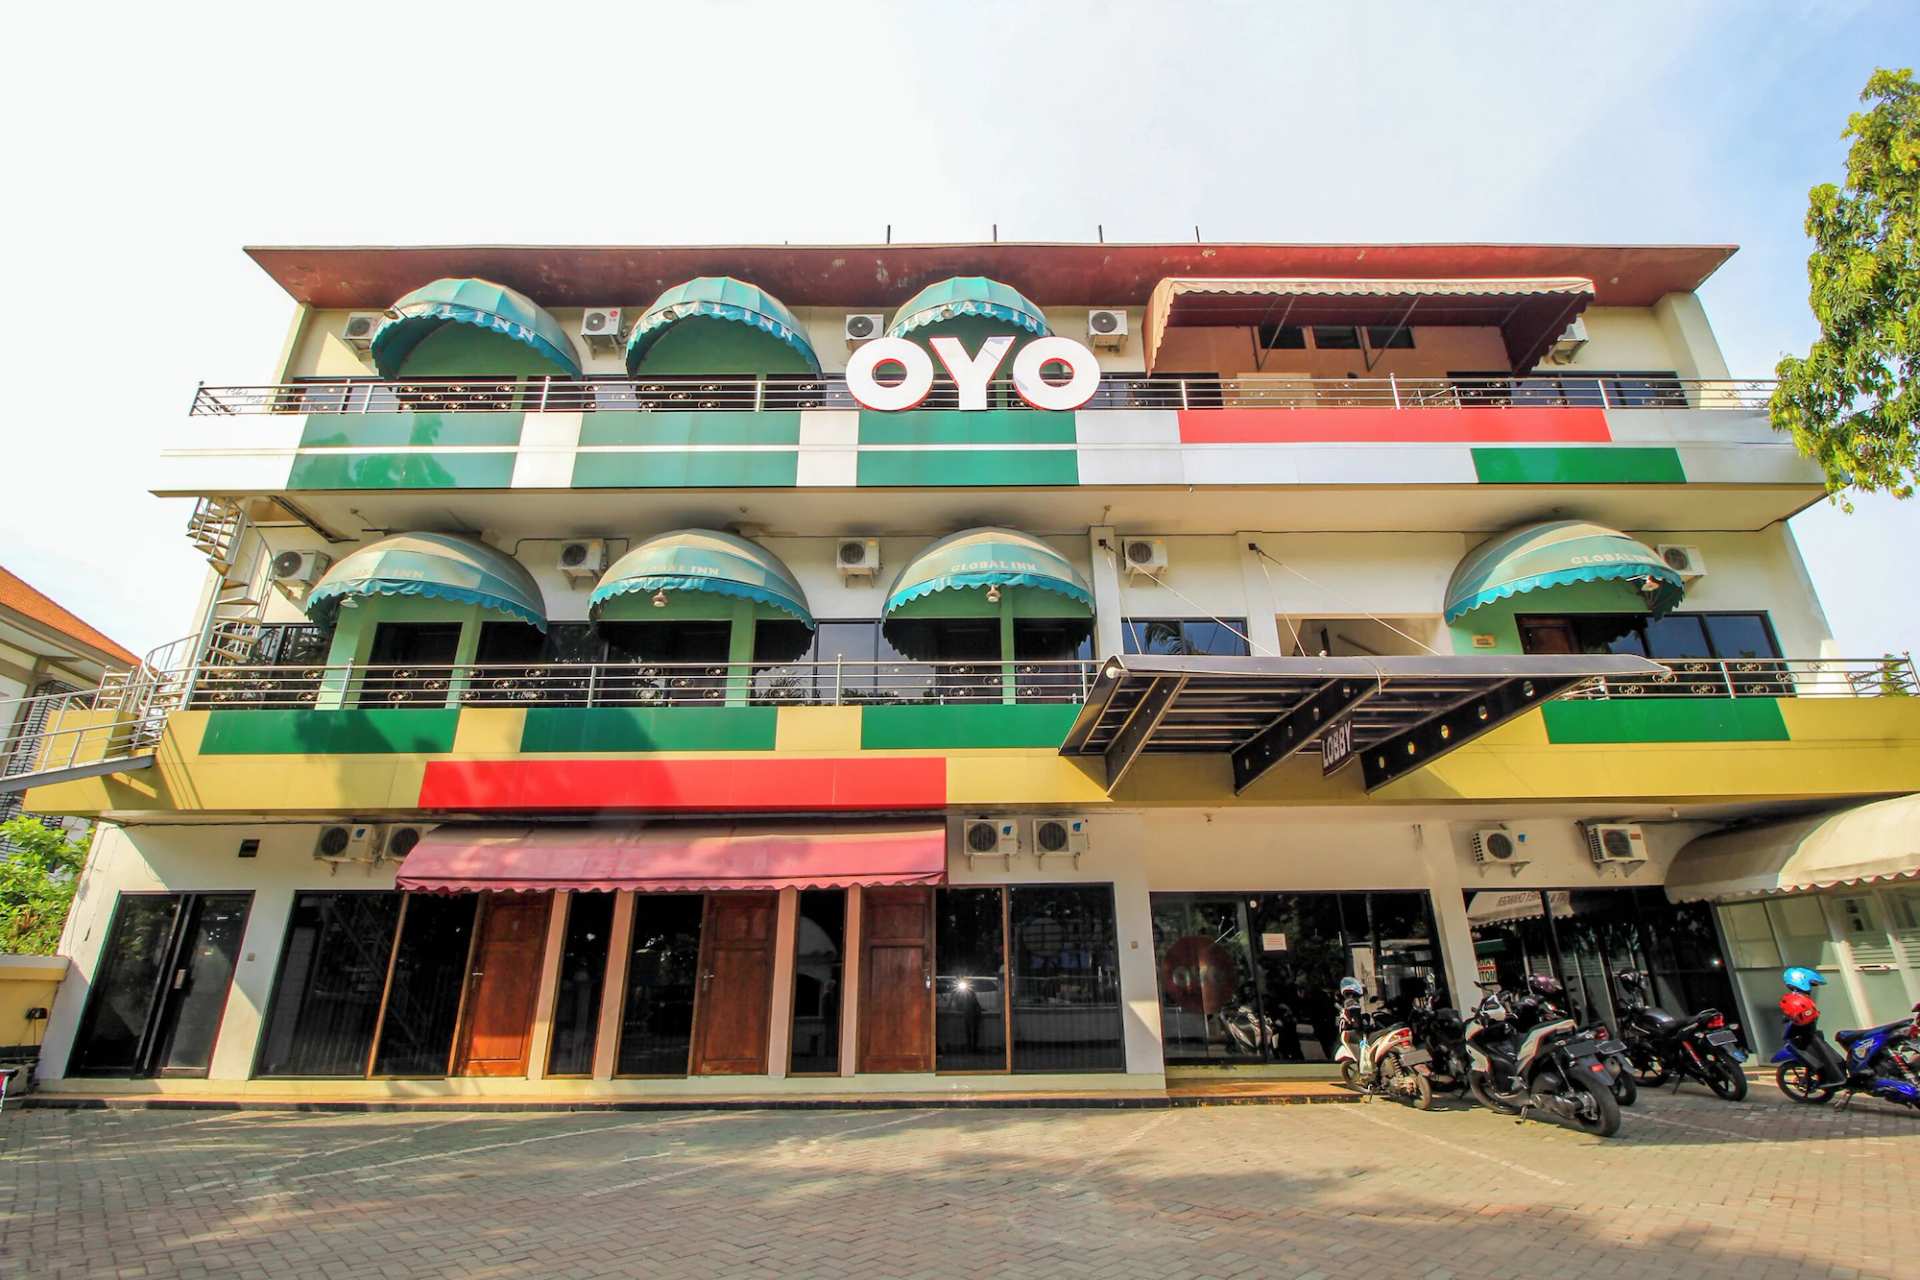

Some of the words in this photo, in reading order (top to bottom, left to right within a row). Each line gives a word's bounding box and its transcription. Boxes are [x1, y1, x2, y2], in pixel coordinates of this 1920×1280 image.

[846, 336, 1101, 411] OYO
[691, 565, 720, 577] INN
[952, 560, 1009, 571] GLOBAL
[1011, 561, 1037, 571] INN
[1321, 720, 1351, 768] LOBBY
